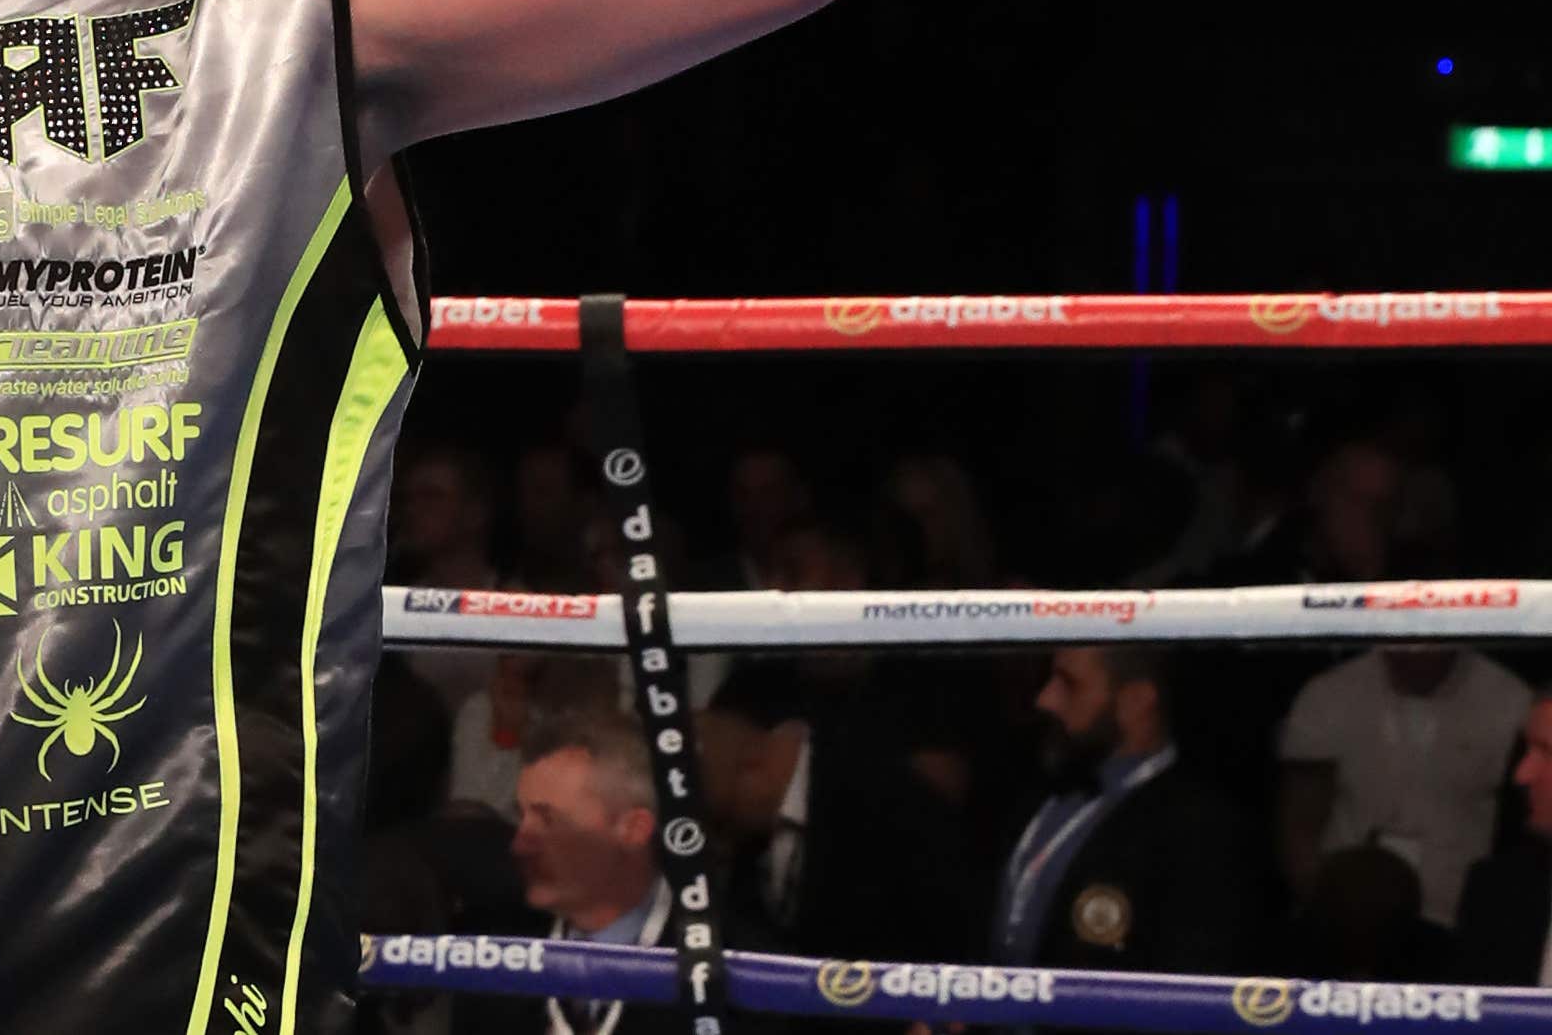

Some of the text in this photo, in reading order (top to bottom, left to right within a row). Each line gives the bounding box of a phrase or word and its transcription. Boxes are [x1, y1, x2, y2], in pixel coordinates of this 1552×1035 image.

[83, 199, 128, 230] Legal
[41, 295, 93, 308] YOUR
[101, 283, 193, 307] AMBITION
[890, 296, 1069, 327] dafabet
[1318, 293, 1501, 326] dafabet
[431, 296, 543, 329] fabet
[47, 468, 178, 521] asphalt
[33, 520, 185, 587] KING
[34, 576, 186, 610] CONSTRUCTION
[462, 592, 591, 615] SPORTS
[864, 600, 1135, 624] matchroomboxing
[623, 504, 688, 798] dafabet
[383, 935, 545, 973] dafabet
[880, 963, 1054, 1006] dafabet
[1299, 981, 1482, 1024] dafabet
